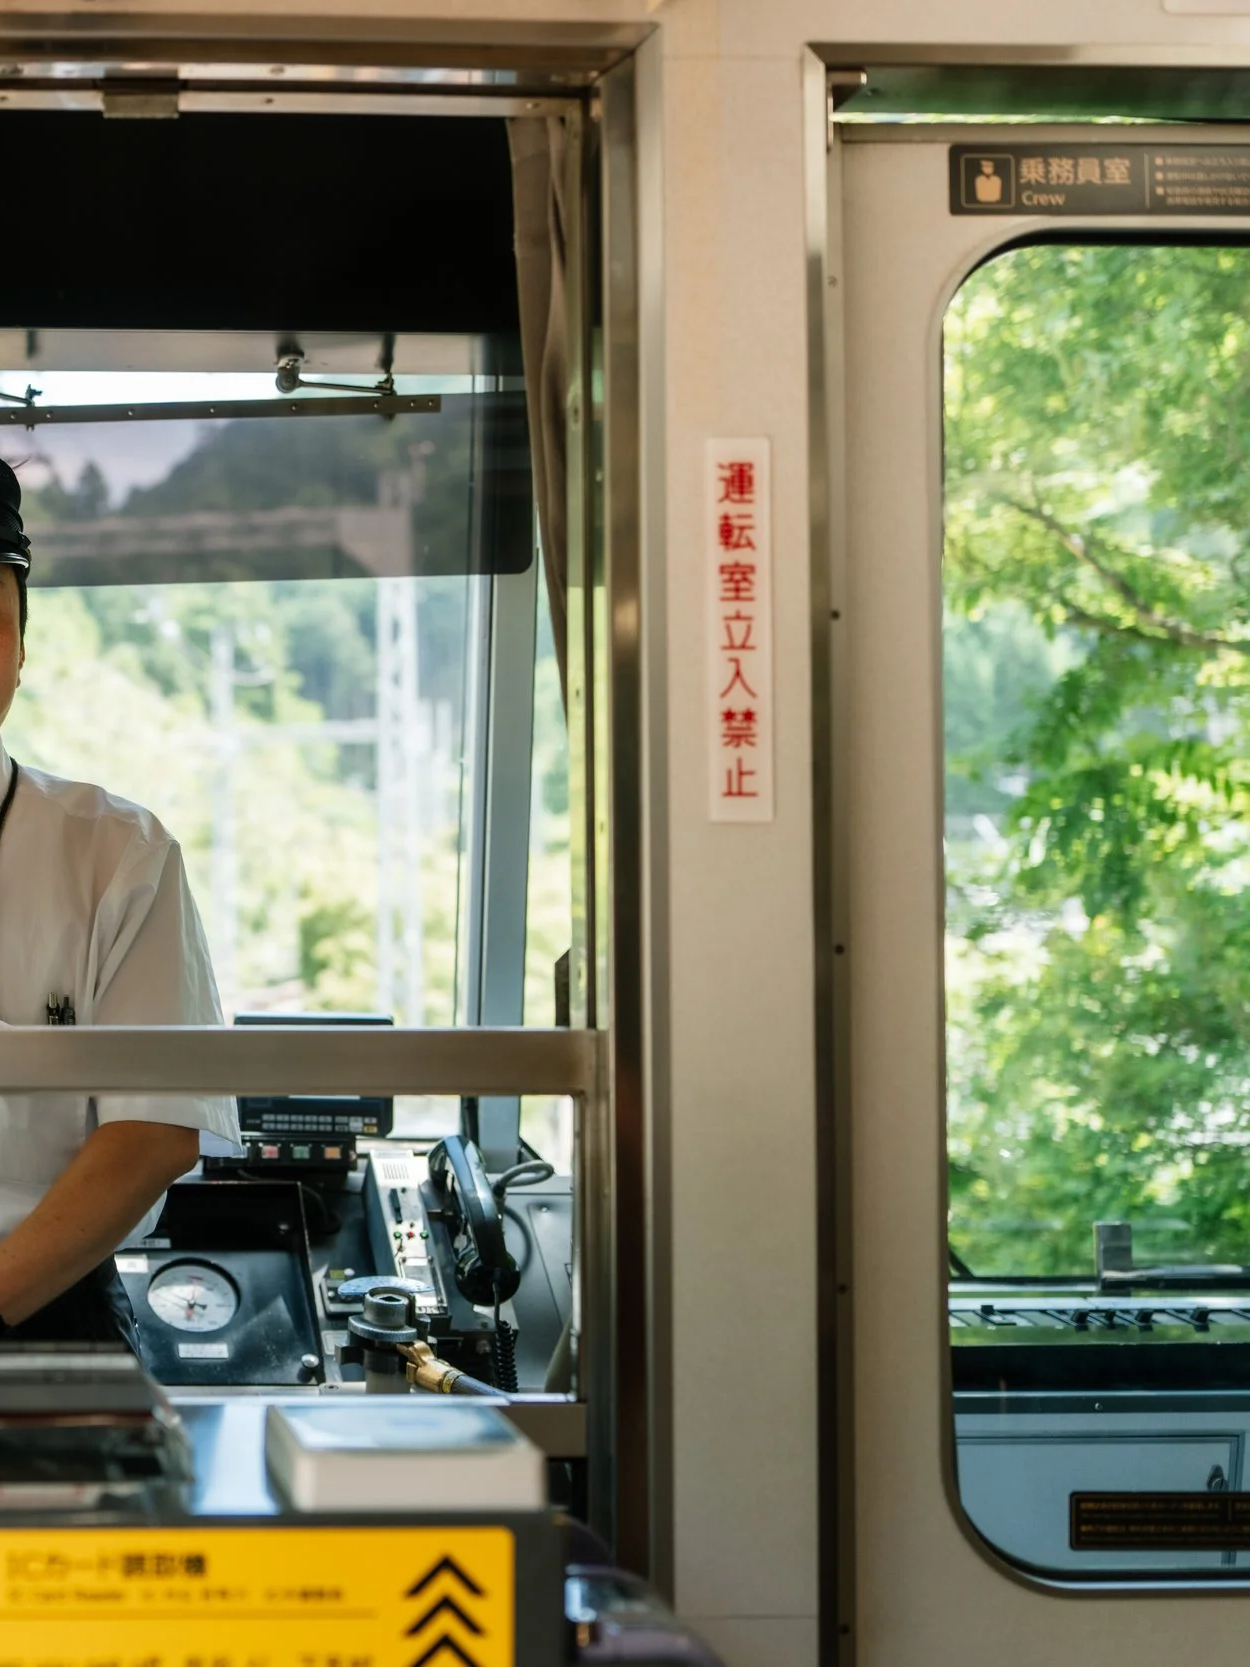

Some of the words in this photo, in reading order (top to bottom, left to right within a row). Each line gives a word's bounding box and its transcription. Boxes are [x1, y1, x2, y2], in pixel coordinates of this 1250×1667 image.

[1019, 157, 1131, 185] 乗務員室
[1022, 191, 1066, 206] Crew
[717, 461, 759, 798] 運転室立入禁止
